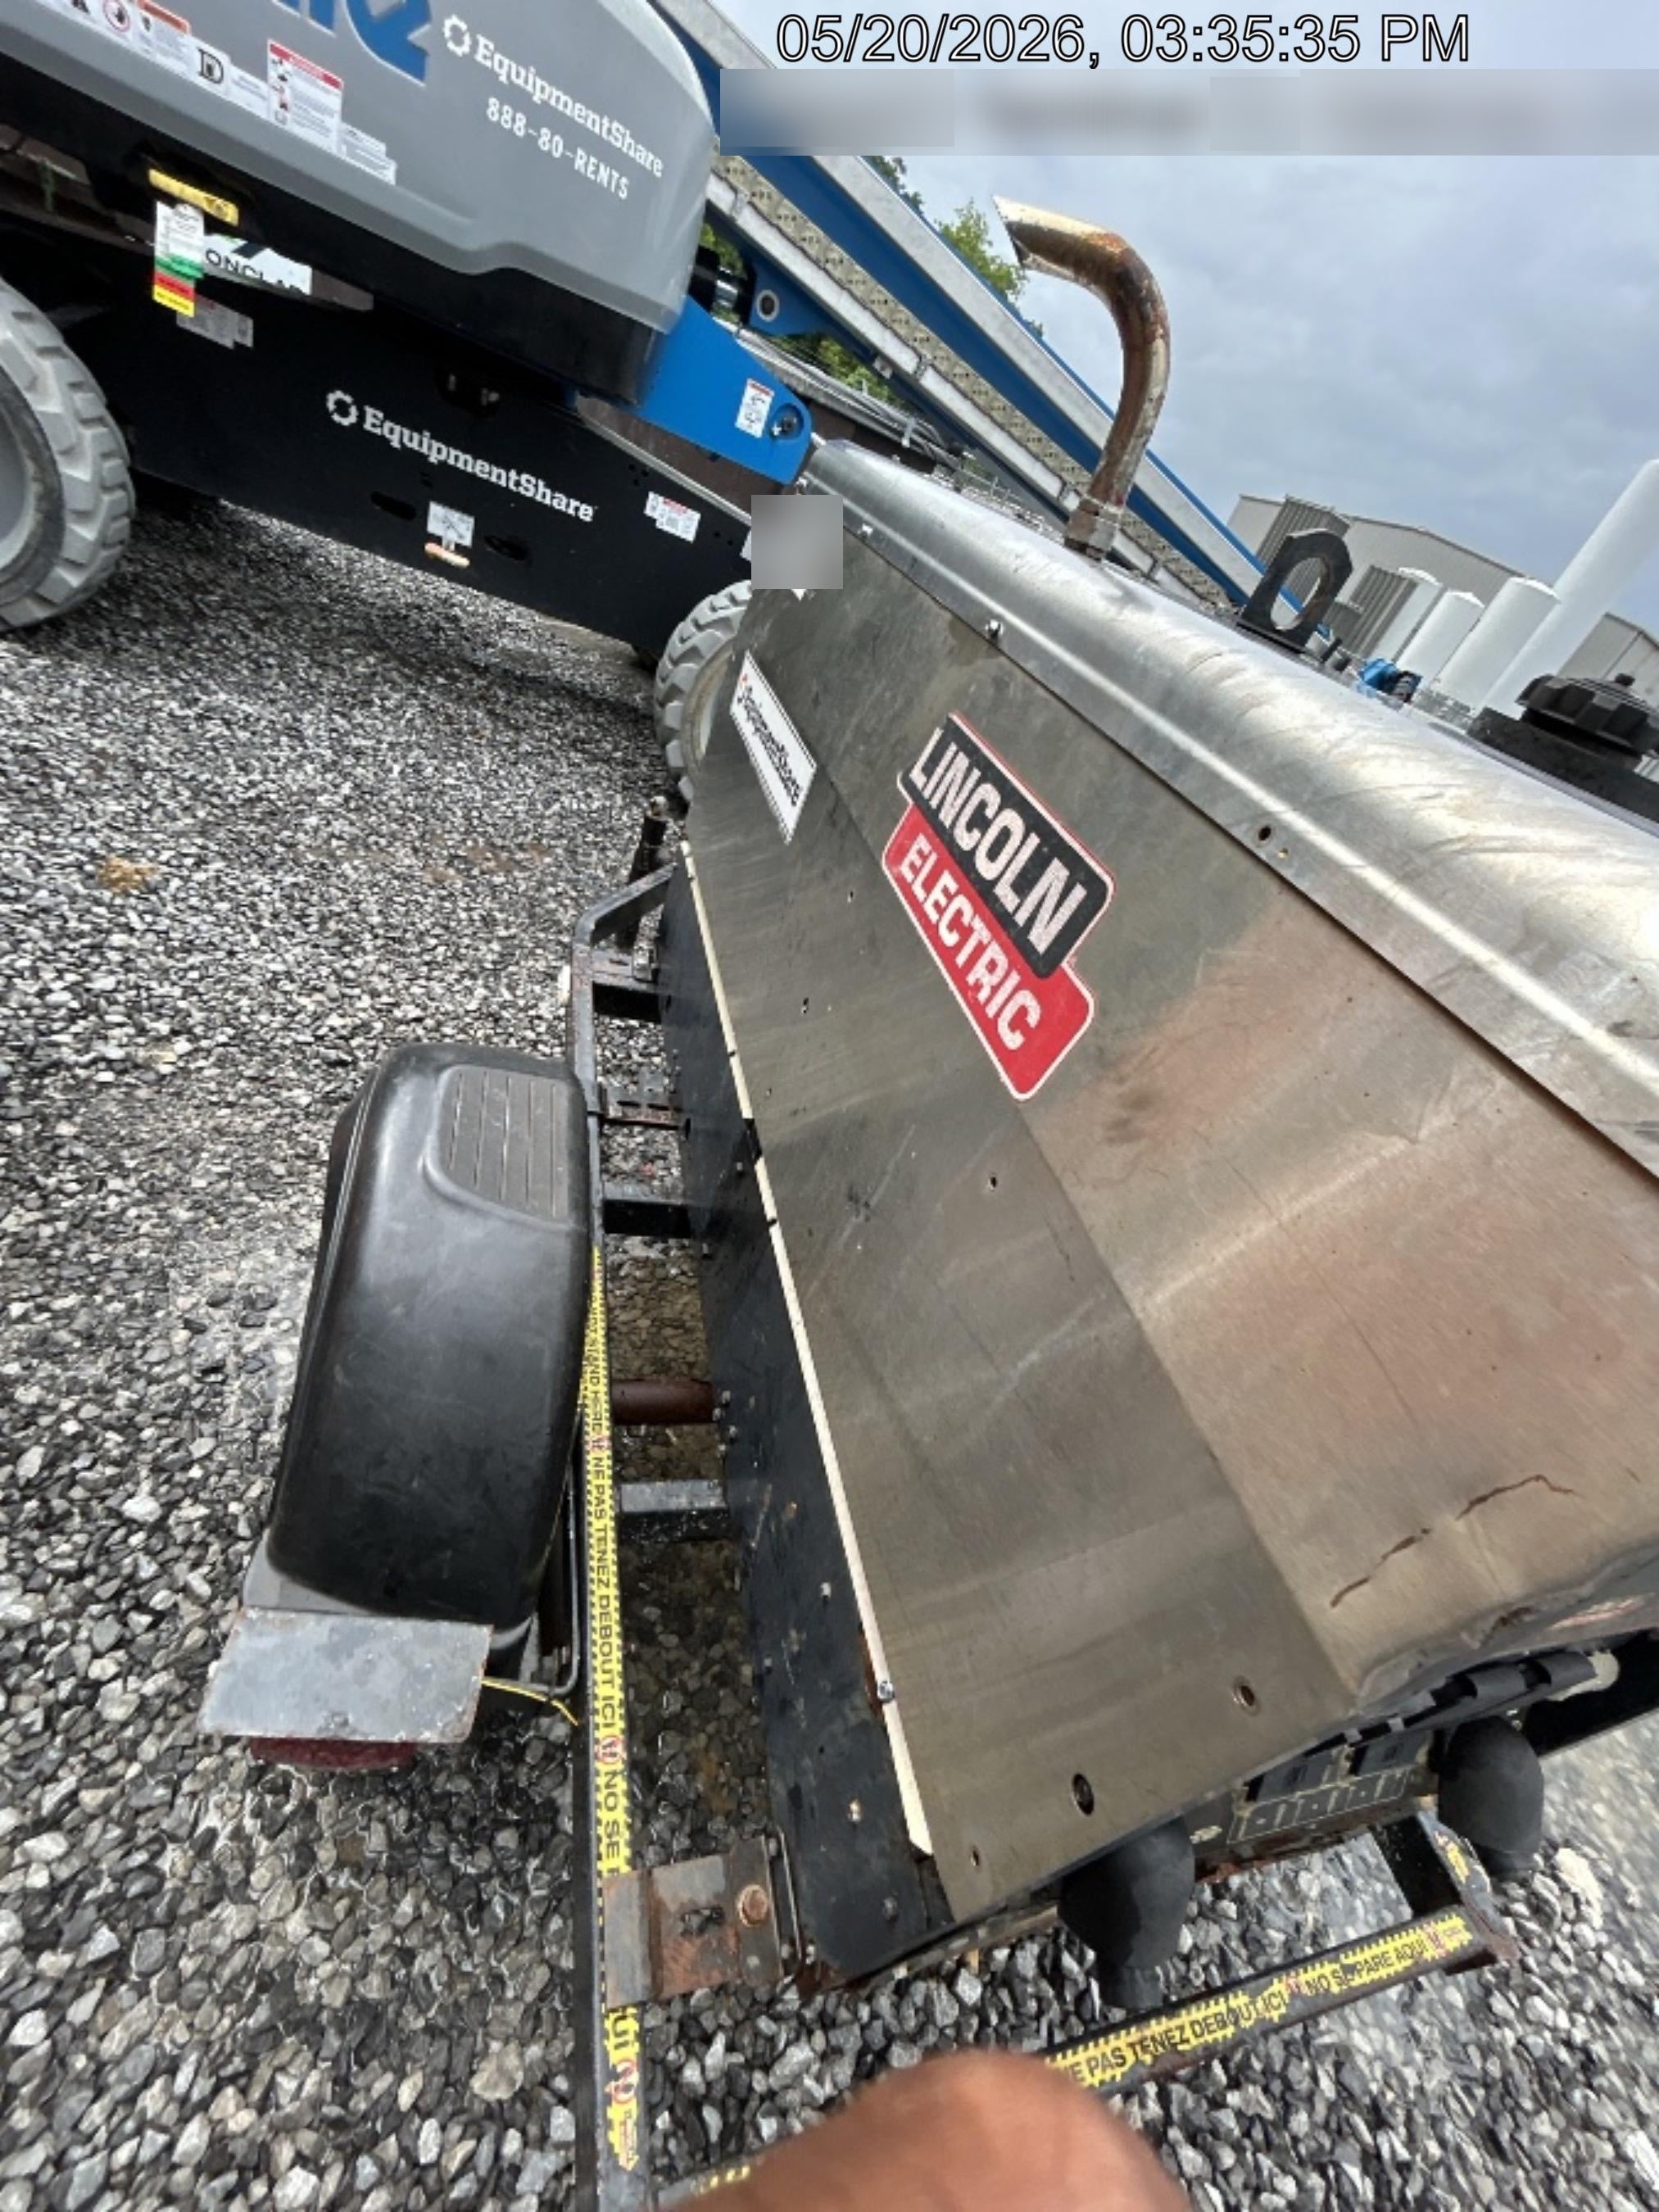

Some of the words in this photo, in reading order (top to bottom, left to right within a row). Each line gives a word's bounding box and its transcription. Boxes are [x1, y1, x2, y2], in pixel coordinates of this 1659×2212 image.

[474, 34, 664, 178] EquipmentShare
[486, 97, 630, 200] 888-80-RENTS
[362, 405, 596, 524] EquipmentShare
[909, 728, 1088, 956] LINCOLN
[898, 833, 1041, 1050] ELECTRIC
[594, 1484, 608, 1521] PAS
[594, 1525, 610, 1589] TENEZ
[599, 1594, 615, 1688] DEBOUT
[602, 1694, 617, 1728] ICI
[603, 1770, 619, 1812] NO
[605, 1820, 620, 1859] SE
[1355, 1950, 1394, 1976] PARE
[1394, 1938, 1430, 1963] AQUI
[1086, 2047, 1127, 2078] PAS
[1126, 2024, 1190, 2060] TENEZ
